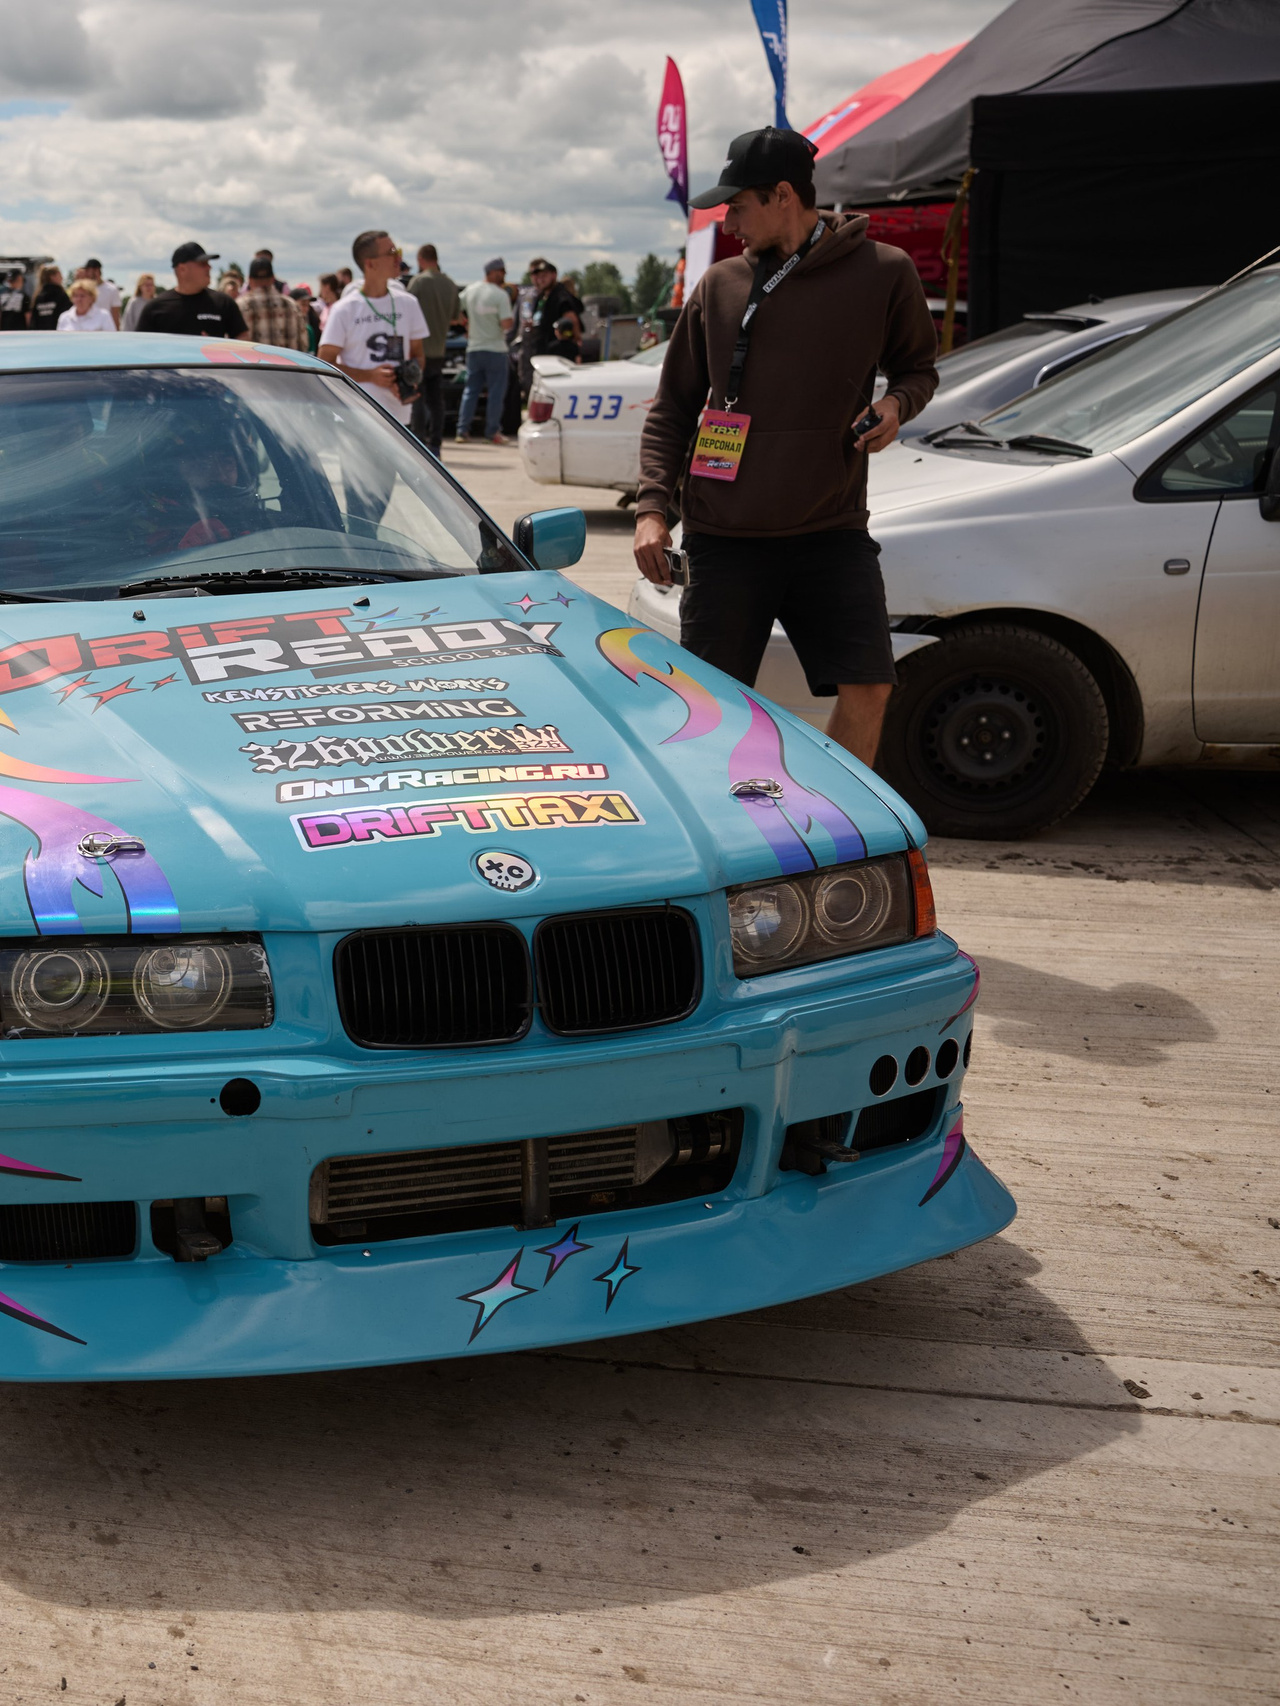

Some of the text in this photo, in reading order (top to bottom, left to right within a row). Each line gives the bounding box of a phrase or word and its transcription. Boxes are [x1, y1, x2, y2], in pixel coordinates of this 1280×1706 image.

[563, 395, 623, 420] 133
[698, 437, 742, 453] ПЕРСОНАЛ
[185, 618, 561, 683] READY
[392, 652, 489, 667] SCHOOL
[491, 648, 510, 657] &
[299, 793, 641, 849] DRIFTTAXI
